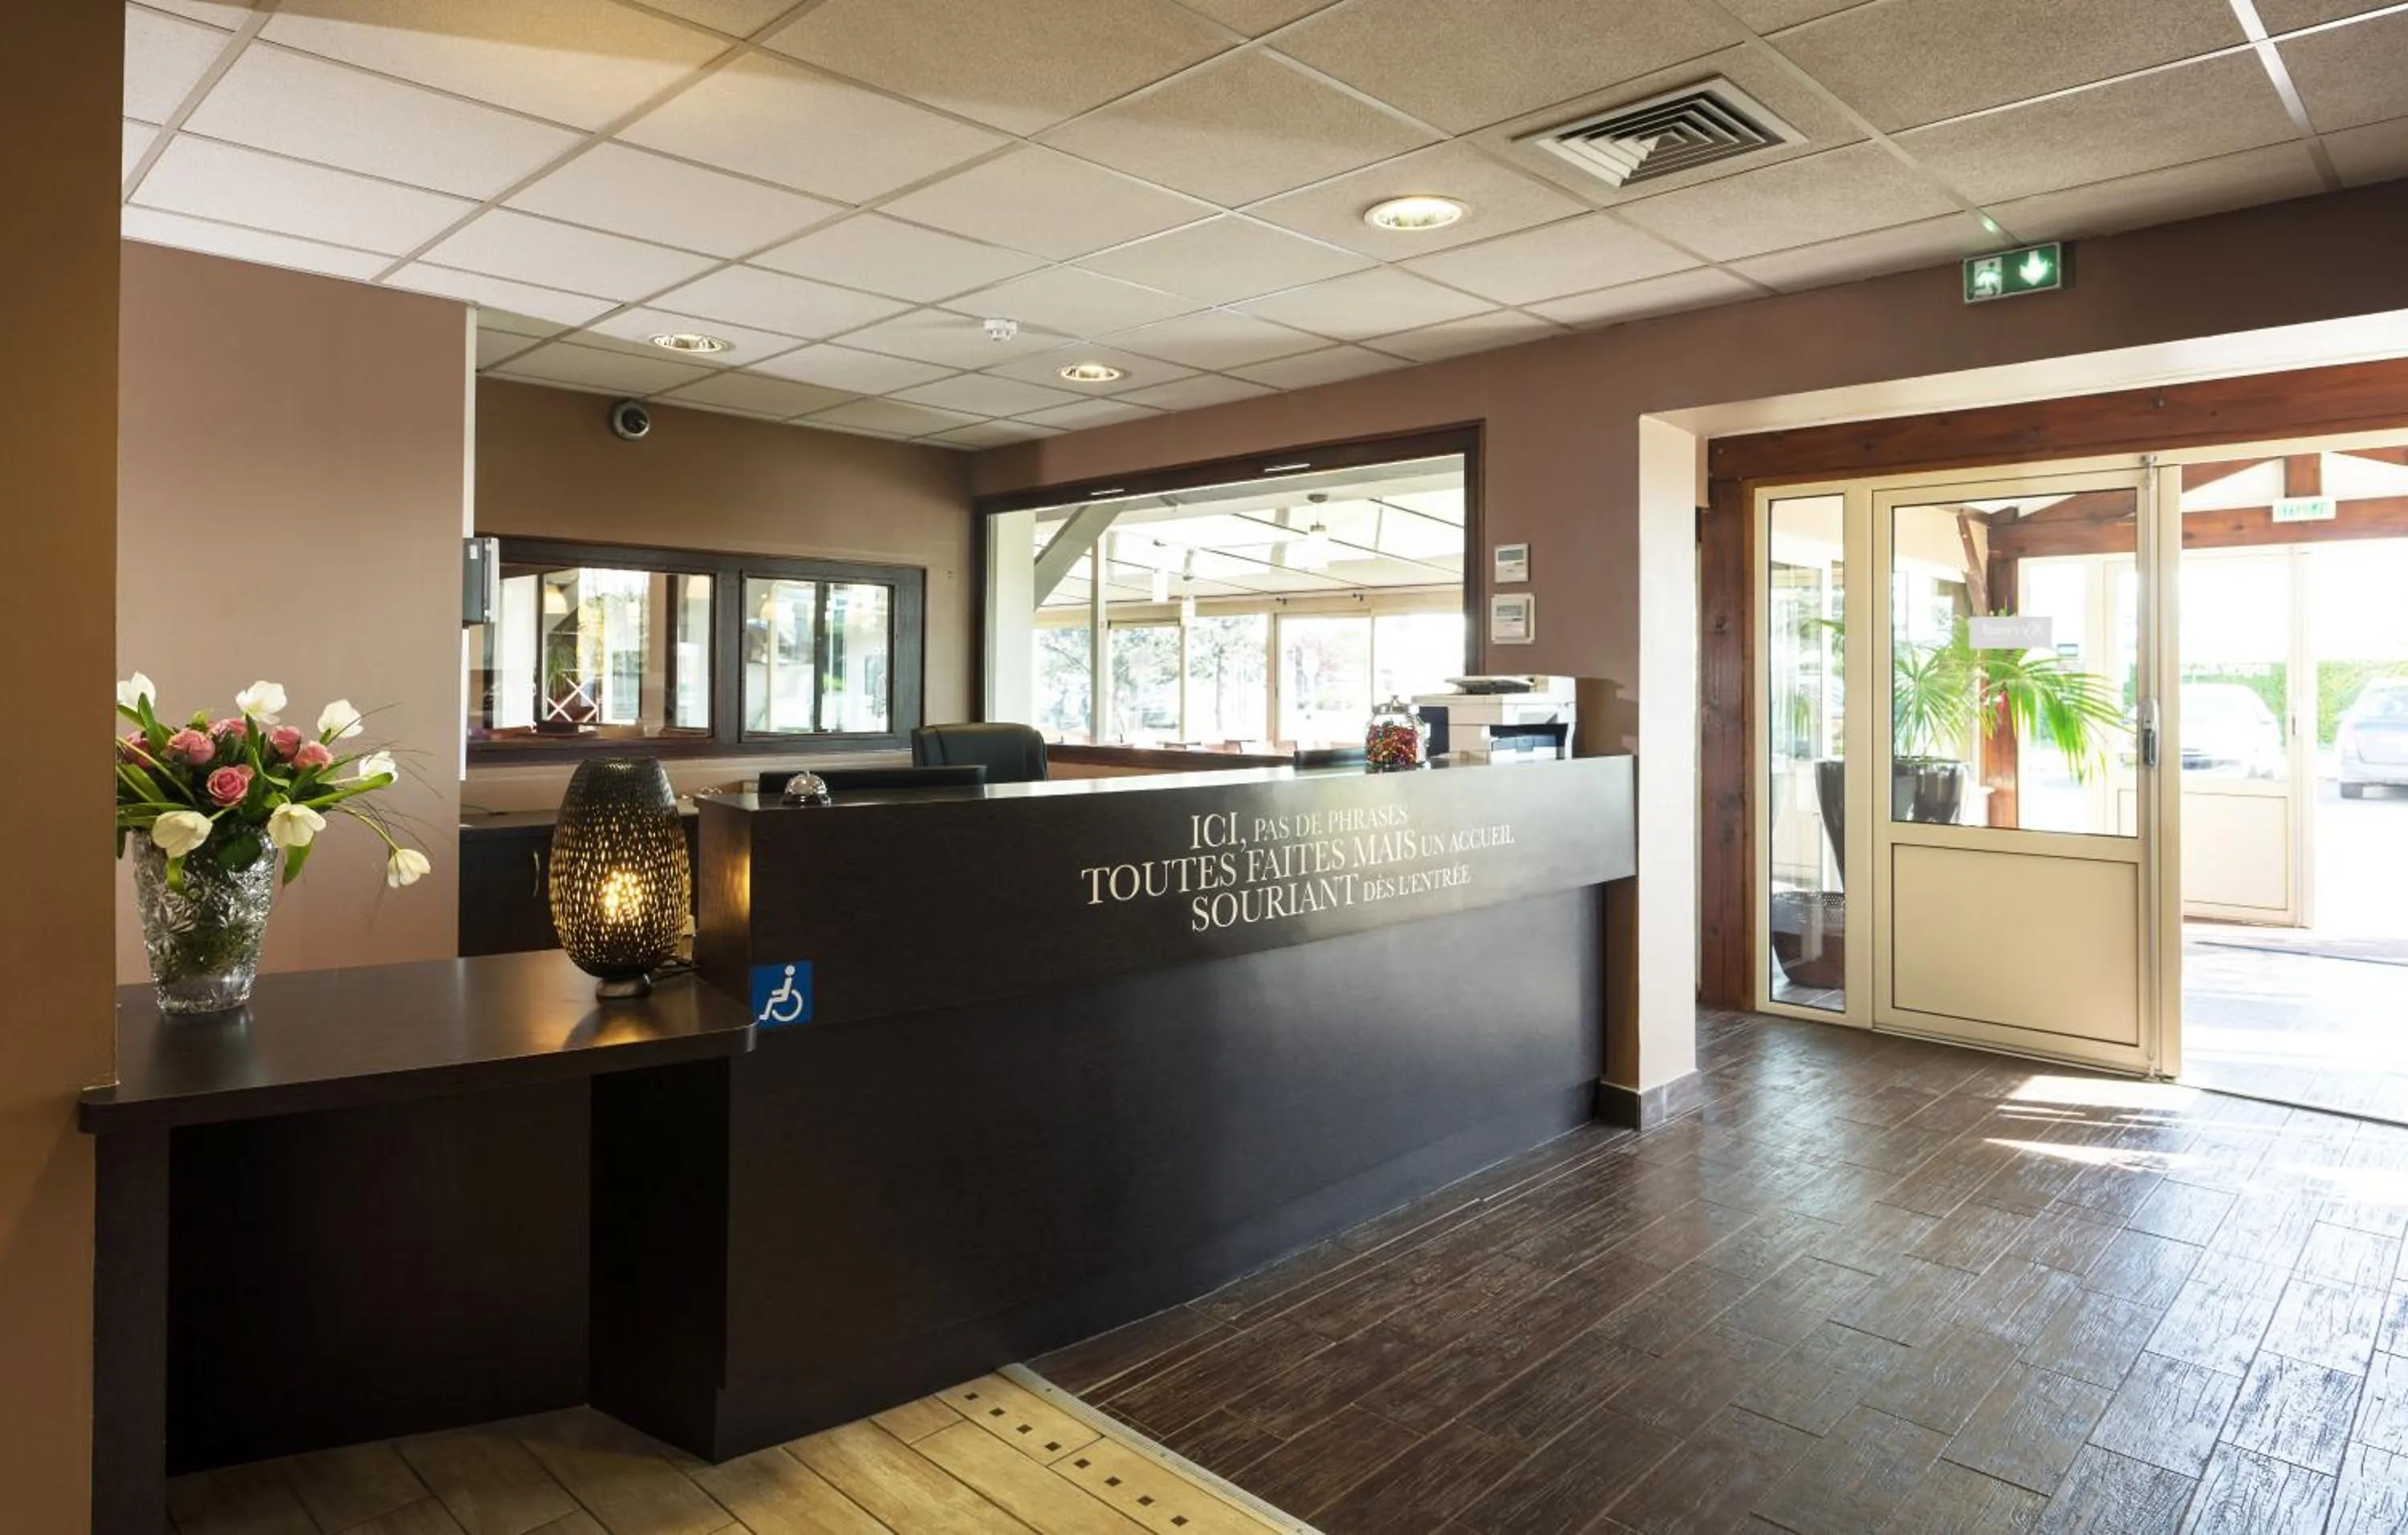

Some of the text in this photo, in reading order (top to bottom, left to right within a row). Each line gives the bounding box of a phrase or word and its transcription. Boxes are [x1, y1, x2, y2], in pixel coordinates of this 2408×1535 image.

[1190, 804, 1408, 852] ICI, PAS DE PHRASES
[1081, 824, 1515, 905] TOUTES FAITES MAIS UN ACCUEIL
[1192, 873, 1360, 932] SOURIANT
[1398, 861, 1471, 896] L'ENTRÉE
